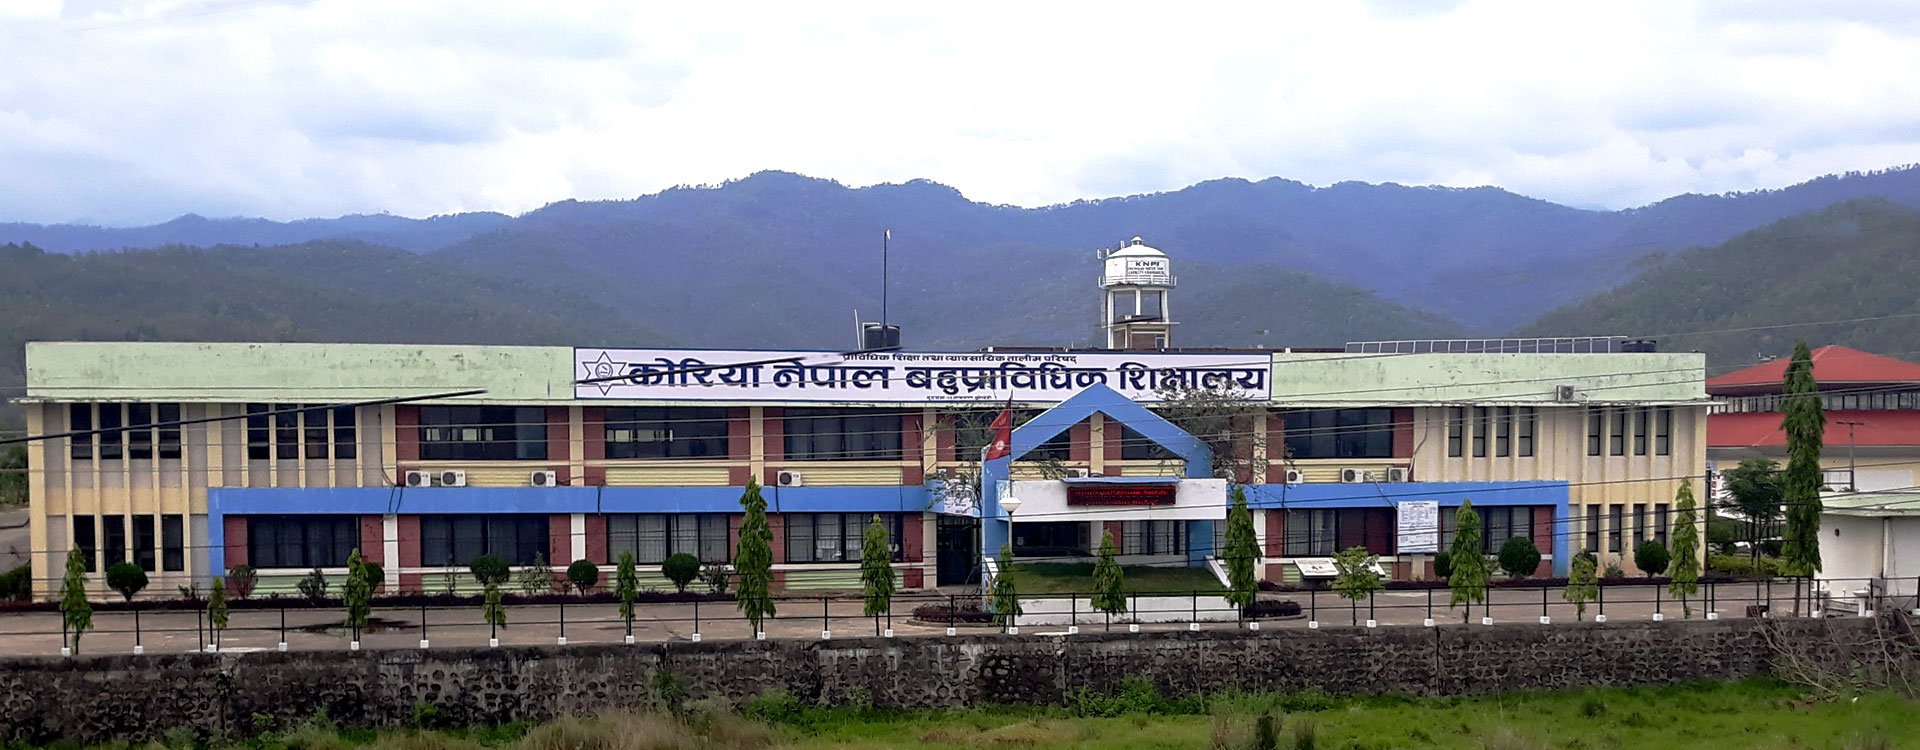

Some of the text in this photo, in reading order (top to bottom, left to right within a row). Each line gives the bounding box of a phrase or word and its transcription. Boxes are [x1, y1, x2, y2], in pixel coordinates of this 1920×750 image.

[892, 353, 920, 361] शिक्षा
[1007, 354, 1042, 362] तालीम
[629, 358, 1267, 394] कोरिया नेपाल बहुप्राविधिक शिक्षालय
